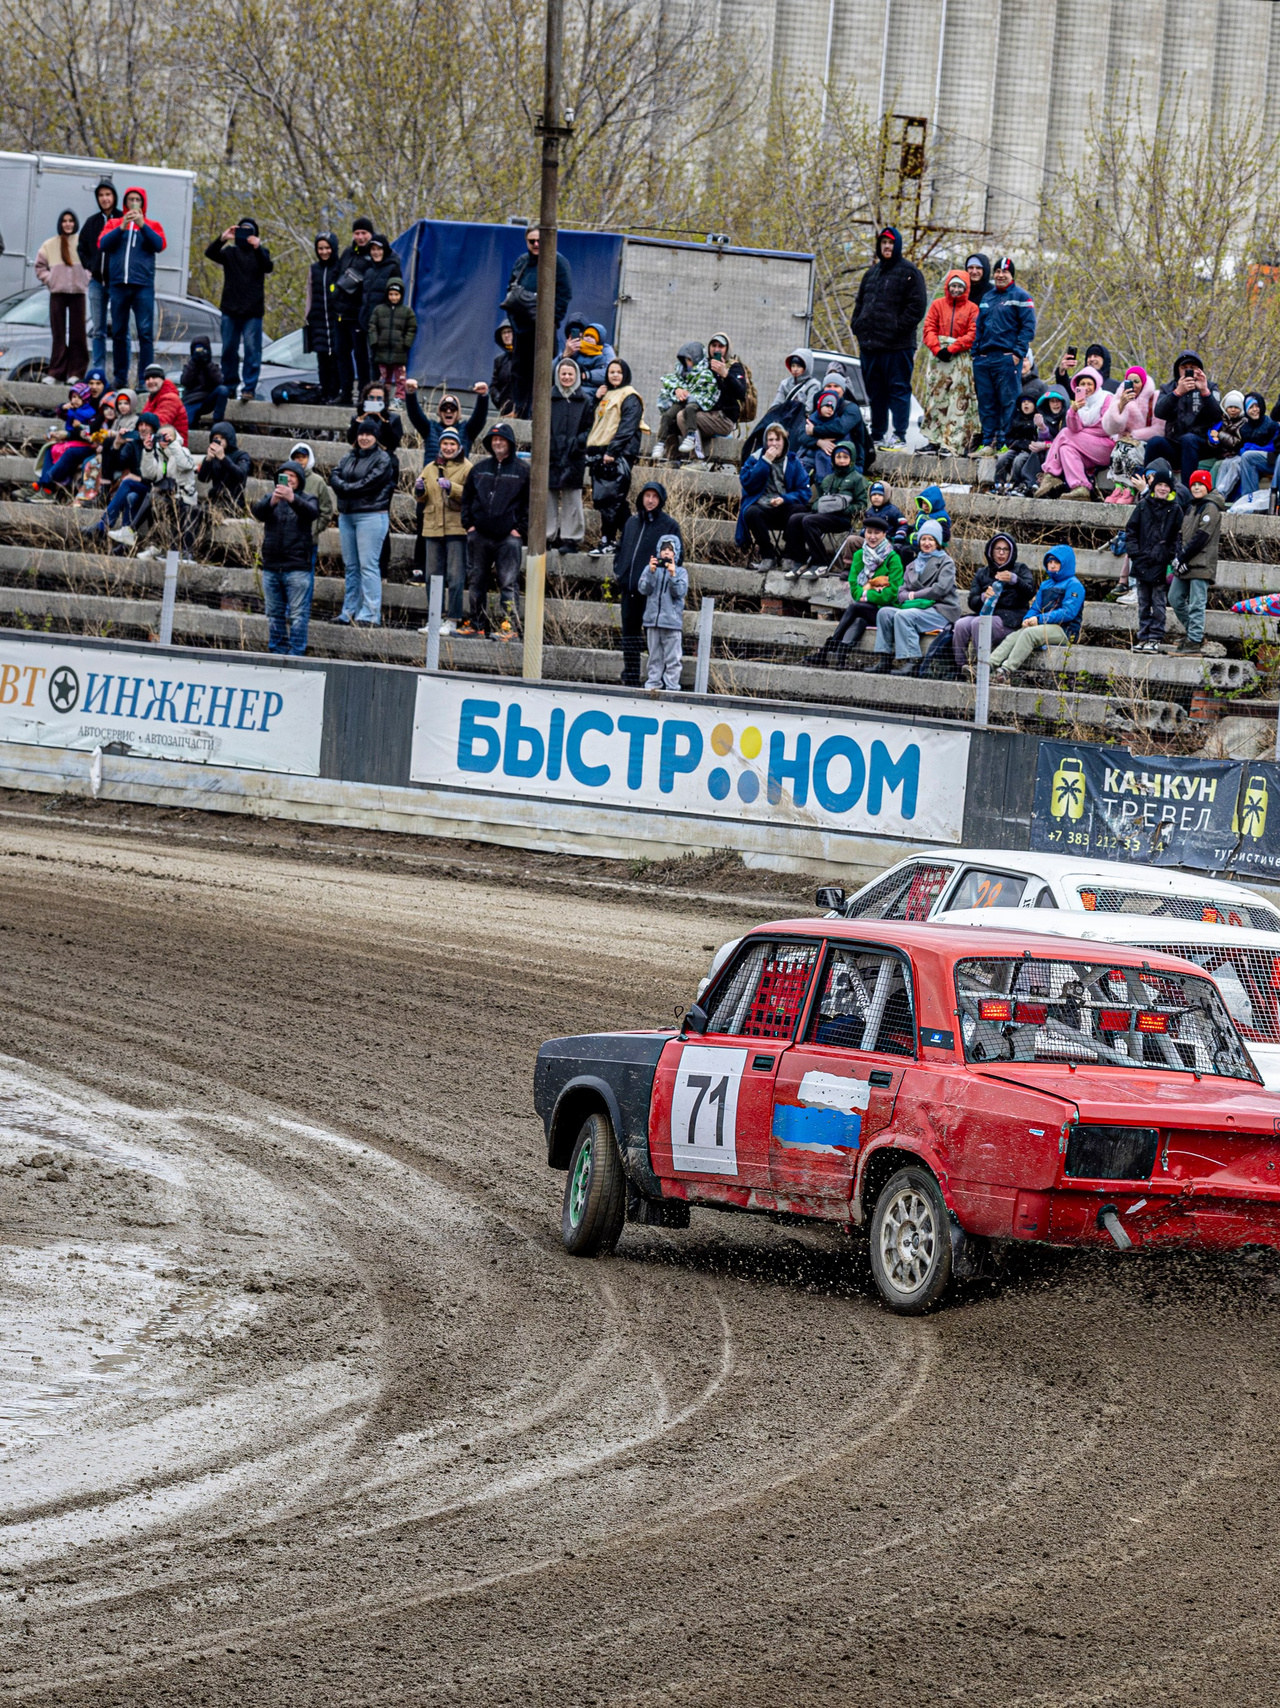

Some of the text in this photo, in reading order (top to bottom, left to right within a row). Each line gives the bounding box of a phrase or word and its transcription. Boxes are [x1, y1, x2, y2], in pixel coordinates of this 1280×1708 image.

[80, 672, 283, 733] ИНЖЕНЕР
[78, 725, 215, 751] АВТОСЕРВИС АВТОЗАПЧАСТИ
[1103, 767, 1218, 803] КАНКУН
[1103, 798, 1212, 832] ТРЕВЕЛ
[1048, 830, 1062, 842] +7
[1067, 831, 1090, 846] 383
[1096, 836, 1117, 849] 212
[686, 1074, 729, 1147] 71
